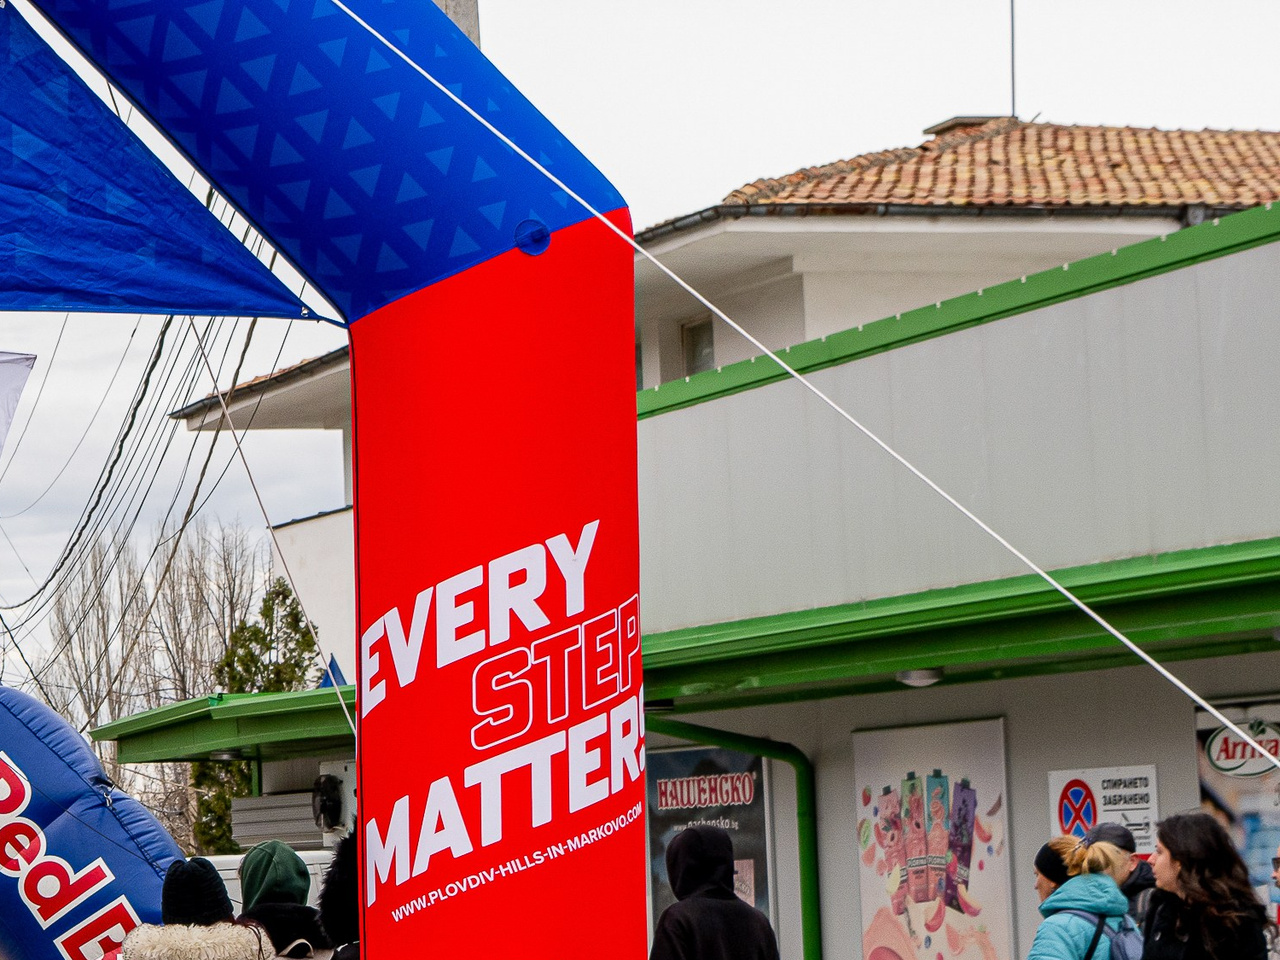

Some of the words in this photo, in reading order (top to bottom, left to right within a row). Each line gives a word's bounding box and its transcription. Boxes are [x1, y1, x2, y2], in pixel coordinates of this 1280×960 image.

[361, 519, 600, 719] EVERY
[471, 593, 641, 751] STEP
[657, 772, 755, 811] НАШЕНСКО
[1101, 776, 1150, 790] СПИРАНЕТО
[1102, 792, 1150, 806] ЗАБРАНЕНО
[391, 801, 643, 922] WWW.PLOVDIV-HILLS-IN-MARKOVO.COM
